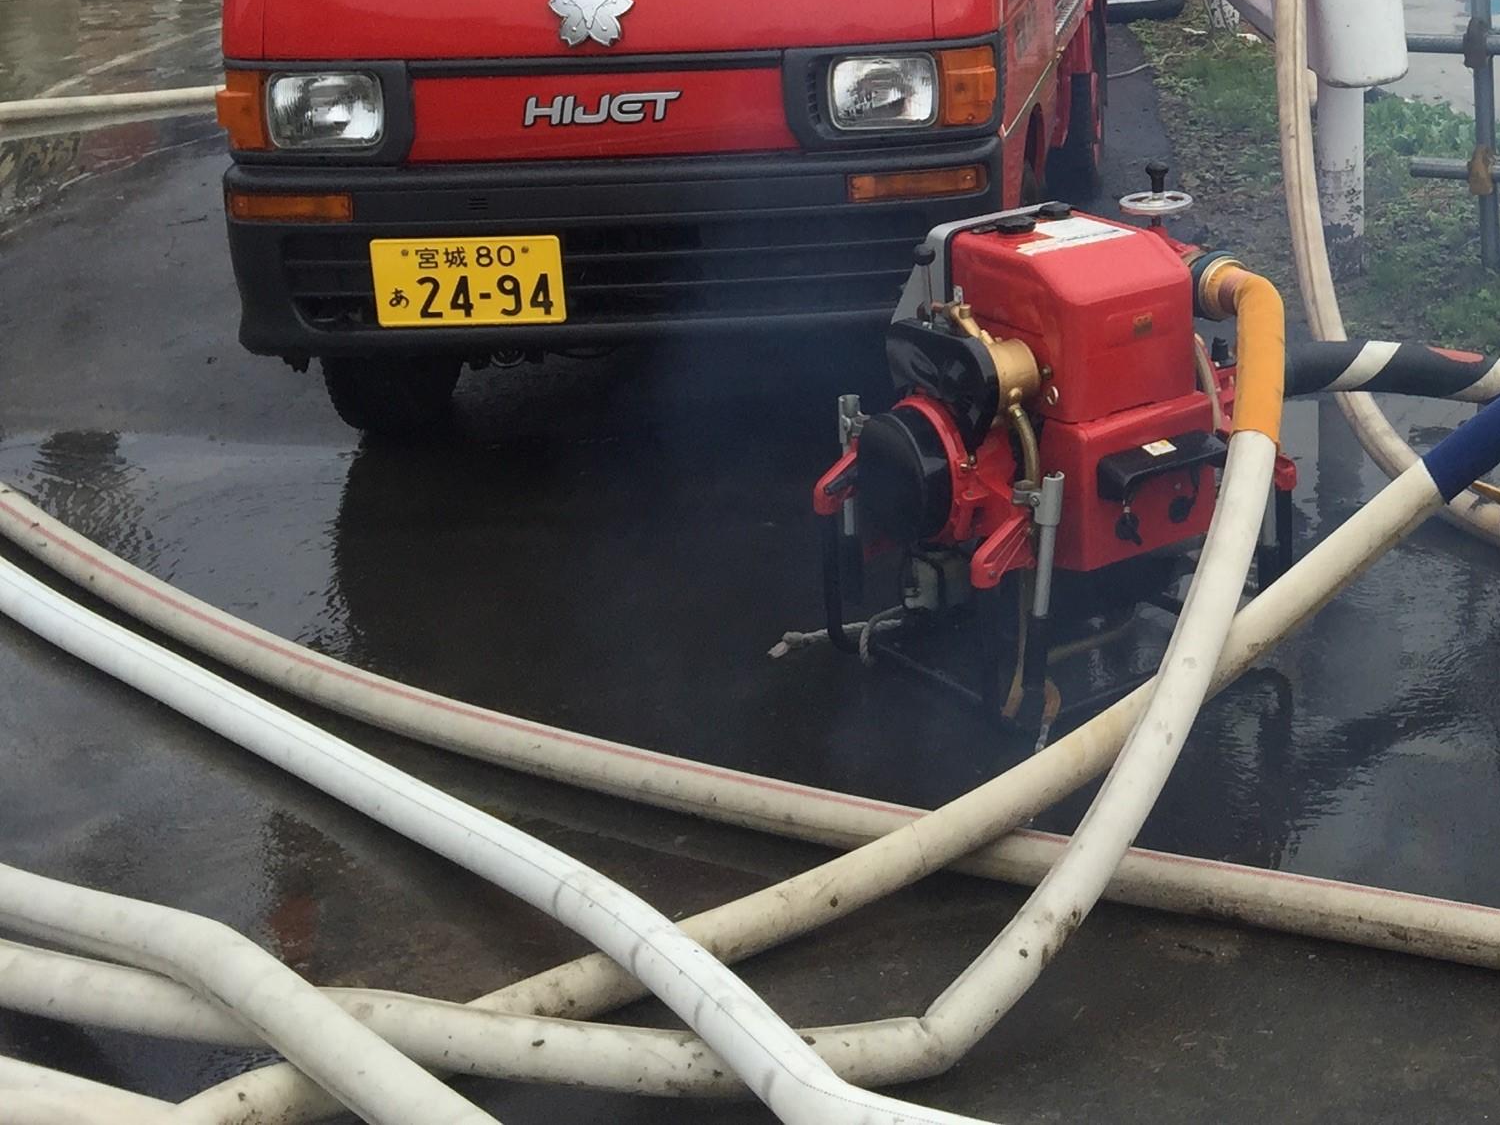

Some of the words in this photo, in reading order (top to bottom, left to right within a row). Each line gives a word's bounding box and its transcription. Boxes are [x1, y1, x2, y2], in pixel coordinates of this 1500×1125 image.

[523, 91, 682, 126] HIJET
[415, 247, 468, 269] 宮城
[475, 245, 515, 267] 80
[389, 288, 409, 309] あ
[416, 273, 554, 318] 24-94
